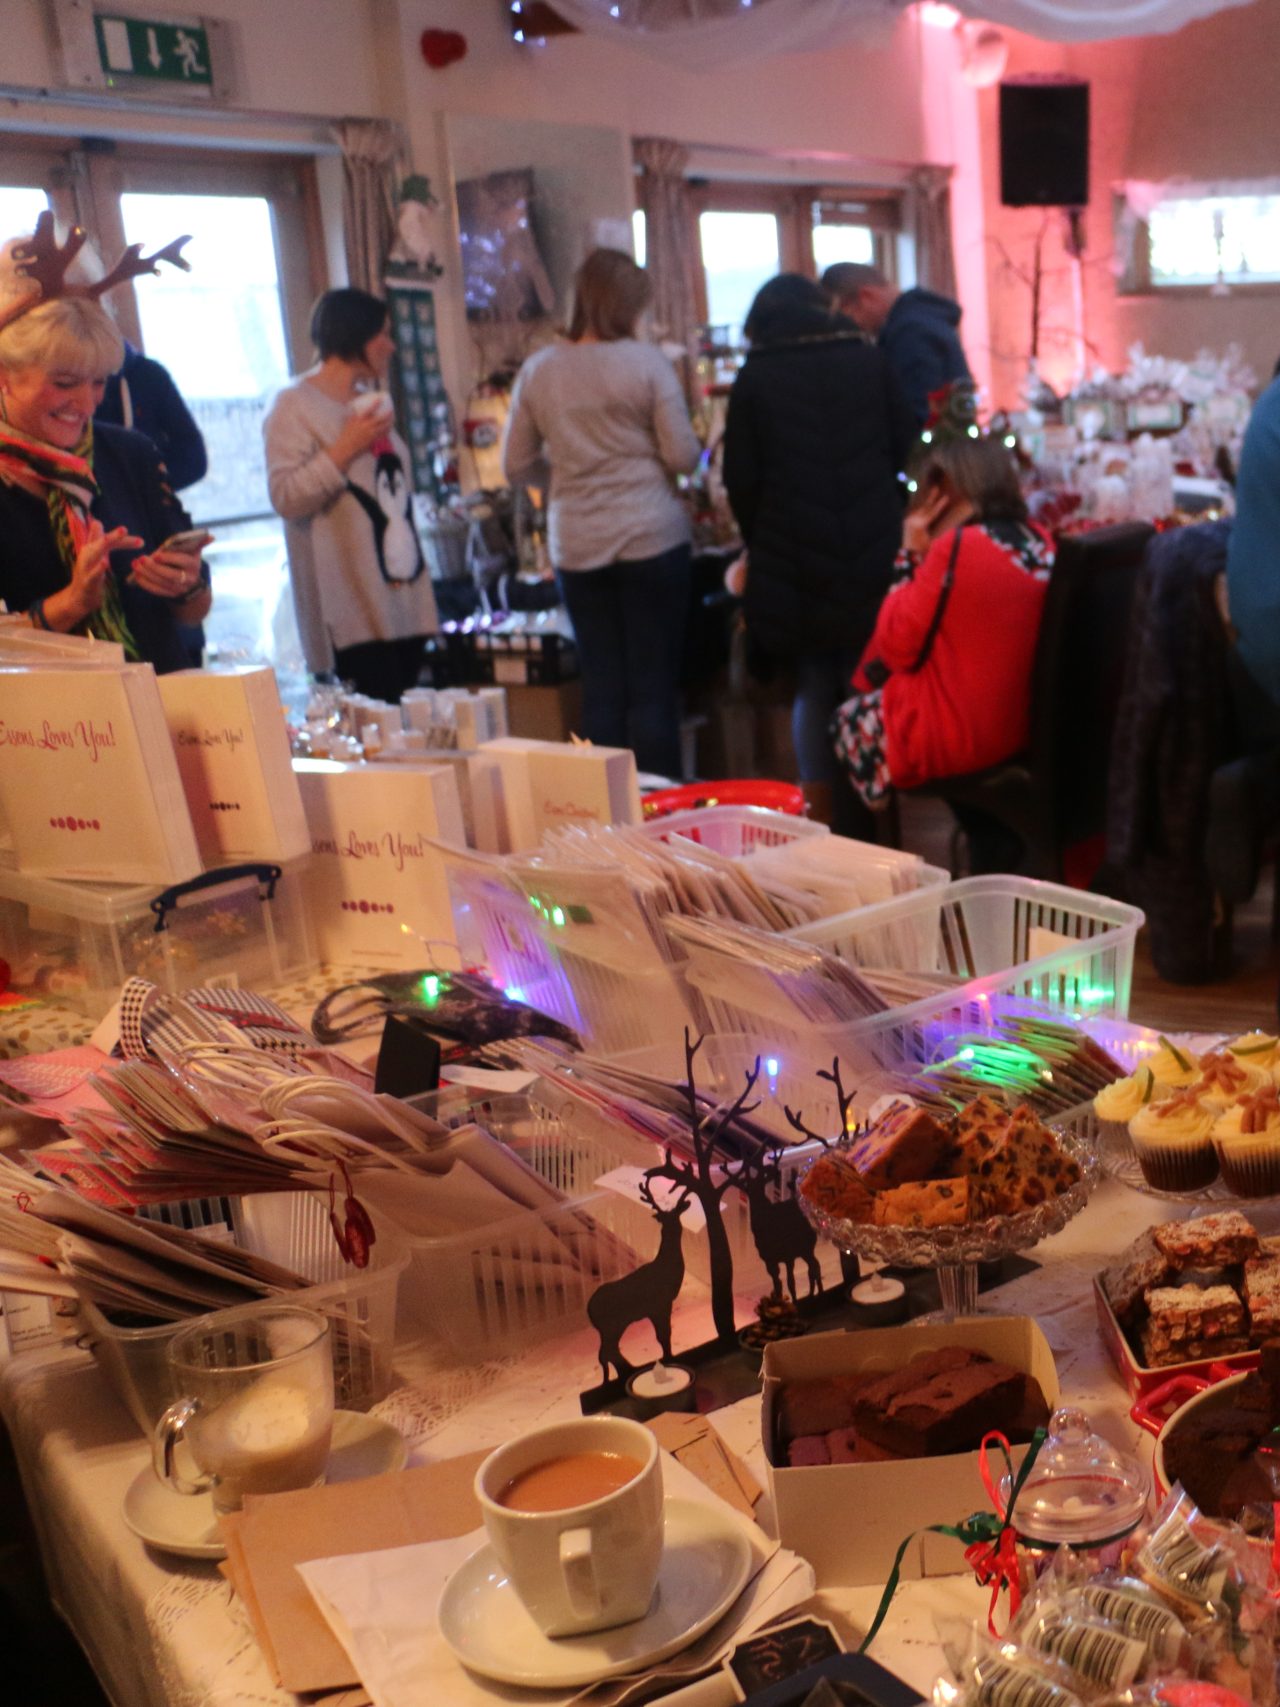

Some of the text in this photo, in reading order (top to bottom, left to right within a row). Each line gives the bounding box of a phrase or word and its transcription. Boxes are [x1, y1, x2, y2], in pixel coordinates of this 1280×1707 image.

[37, 719, 75, 751] Loves
[75, 718, 116, 763] You!
[340, 830, 380, 860] Loves
[381, 830, 424, 872] You!
